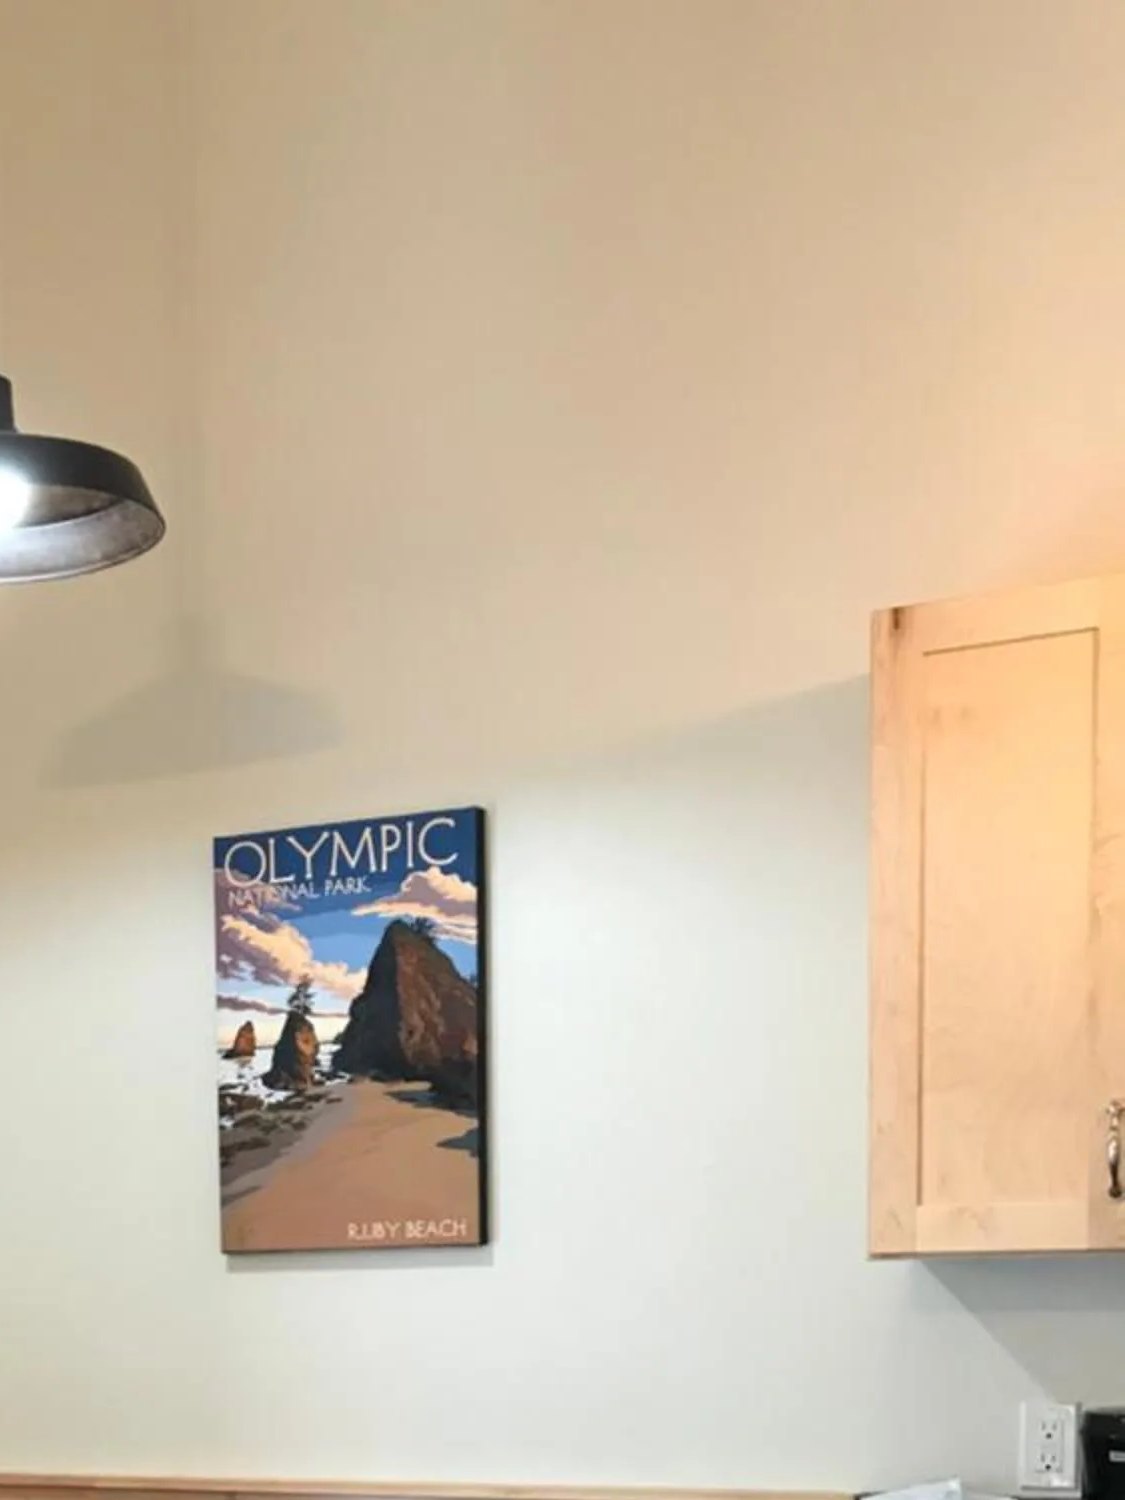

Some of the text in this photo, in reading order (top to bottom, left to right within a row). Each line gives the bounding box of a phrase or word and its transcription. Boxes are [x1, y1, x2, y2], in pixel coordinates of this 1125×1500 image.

[224, 816, 459, 887] OLYMPIC
[228, 875, 373, 908] NATONAL PARK
[346, 1217, 468, 1240] RUBY BEACH
